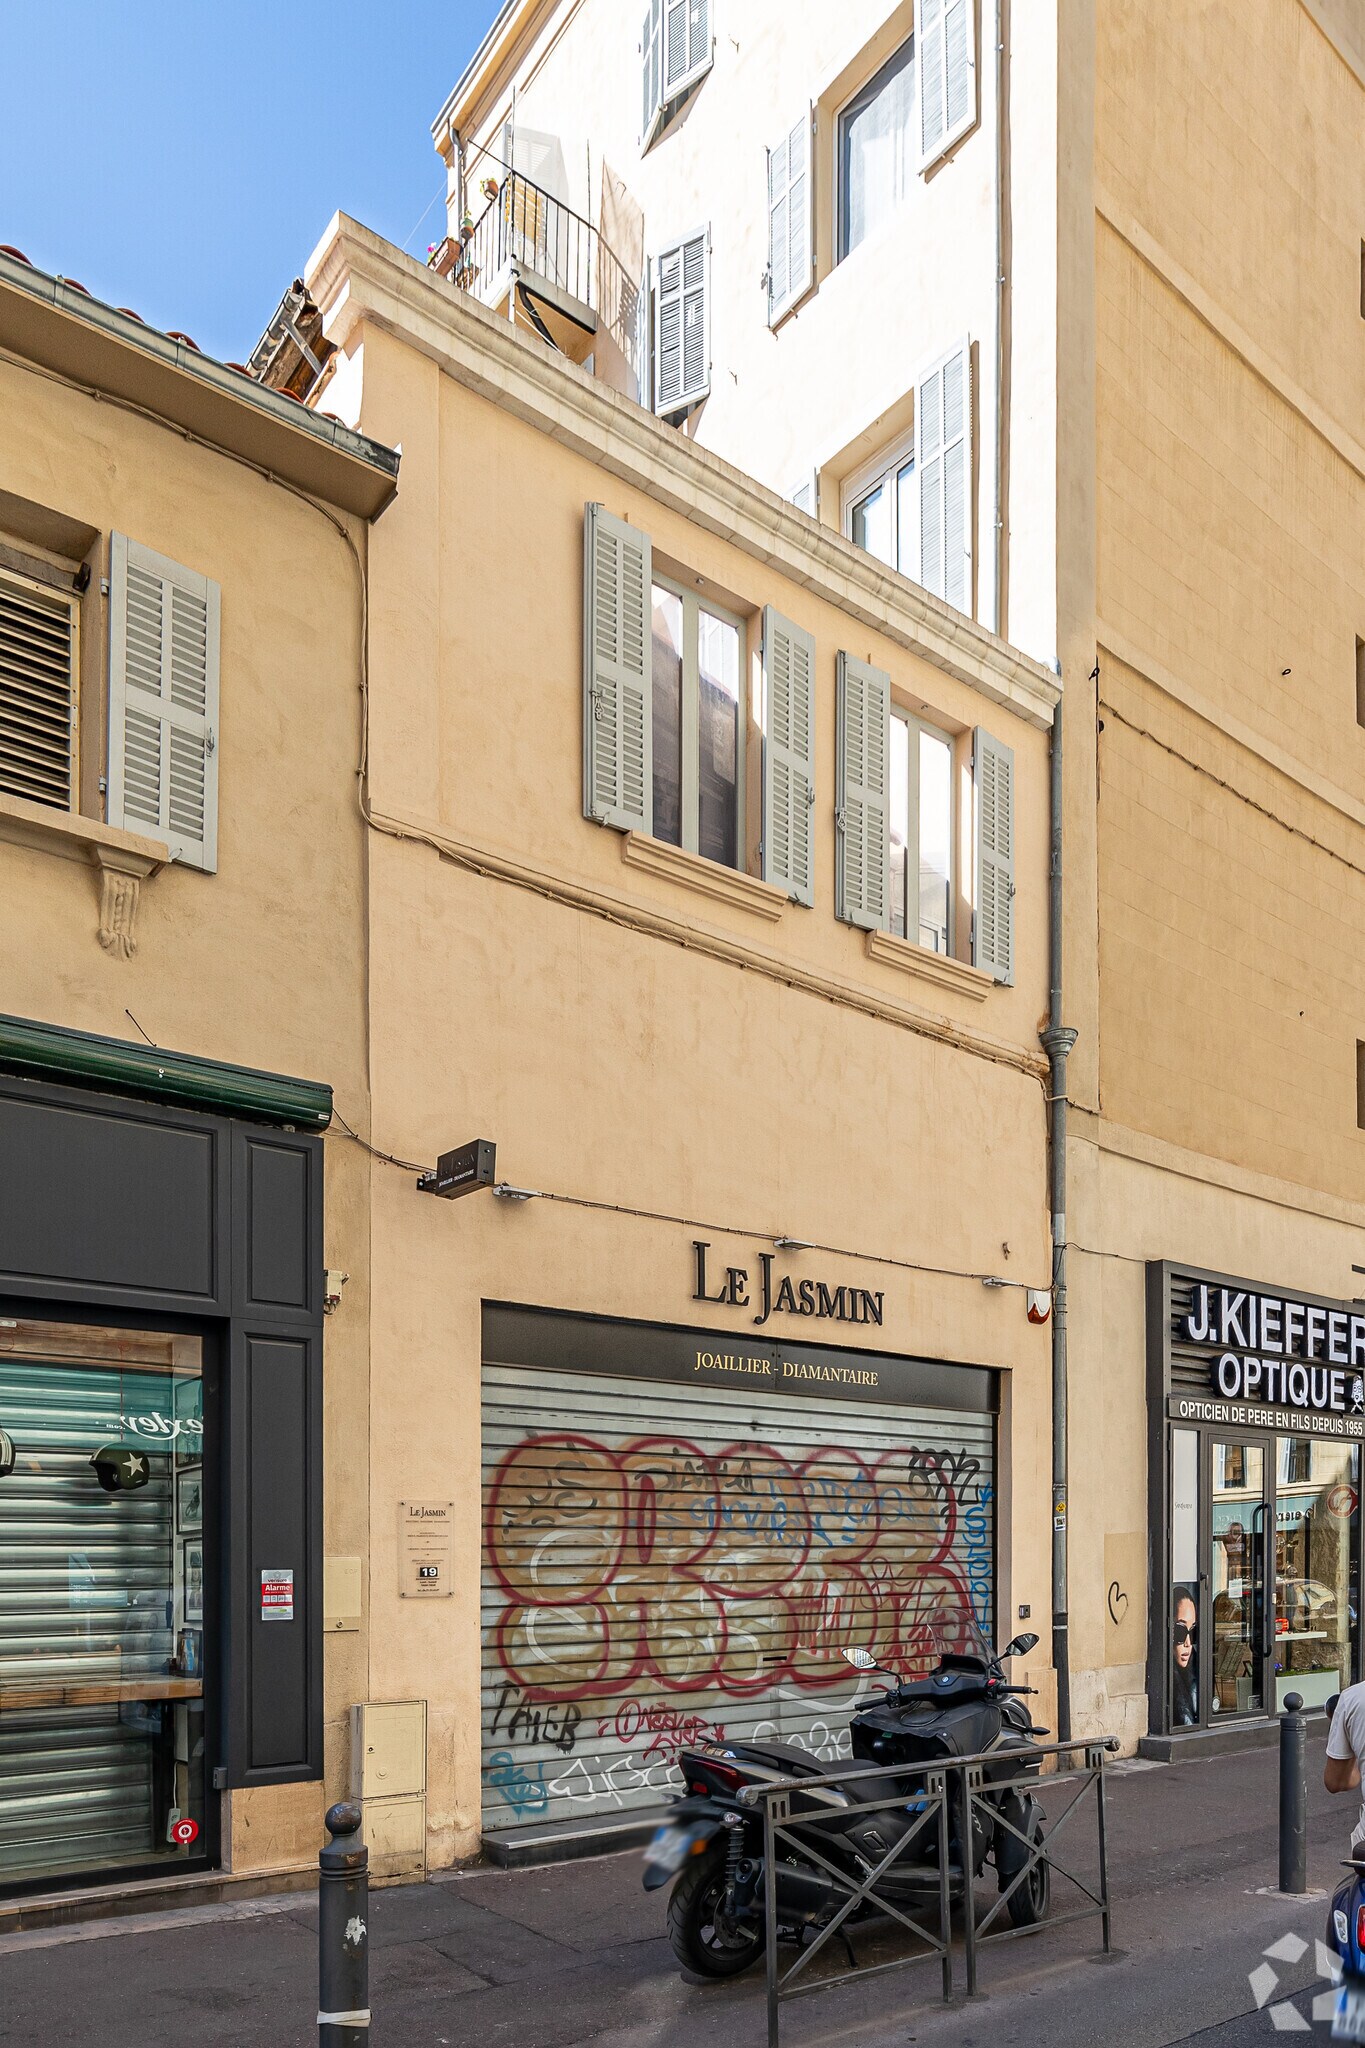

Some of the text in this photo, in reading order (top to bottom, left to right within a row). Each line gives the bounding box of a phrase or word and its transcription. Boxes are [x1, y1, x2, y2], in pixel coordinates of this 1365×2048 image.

[692, 1240, 885, 1326] LE JASMIN
[1187, 1284, 1365, 1365] J.KIEFFER
[694, 1352, 772, 1375] JOAILLIER
[782, 1362, 879, 1386] DIAMANTAIRE
[1218, 1353, 1346, 1411] OPTIQUE
[1179, 1400, 1364, 1436] OPTICIEN DE PERE EN FILS DEPUIS 1955
[410, 1506, 446, 1518] LE JASMIN
[422, 1567, 437, 1577] 19
